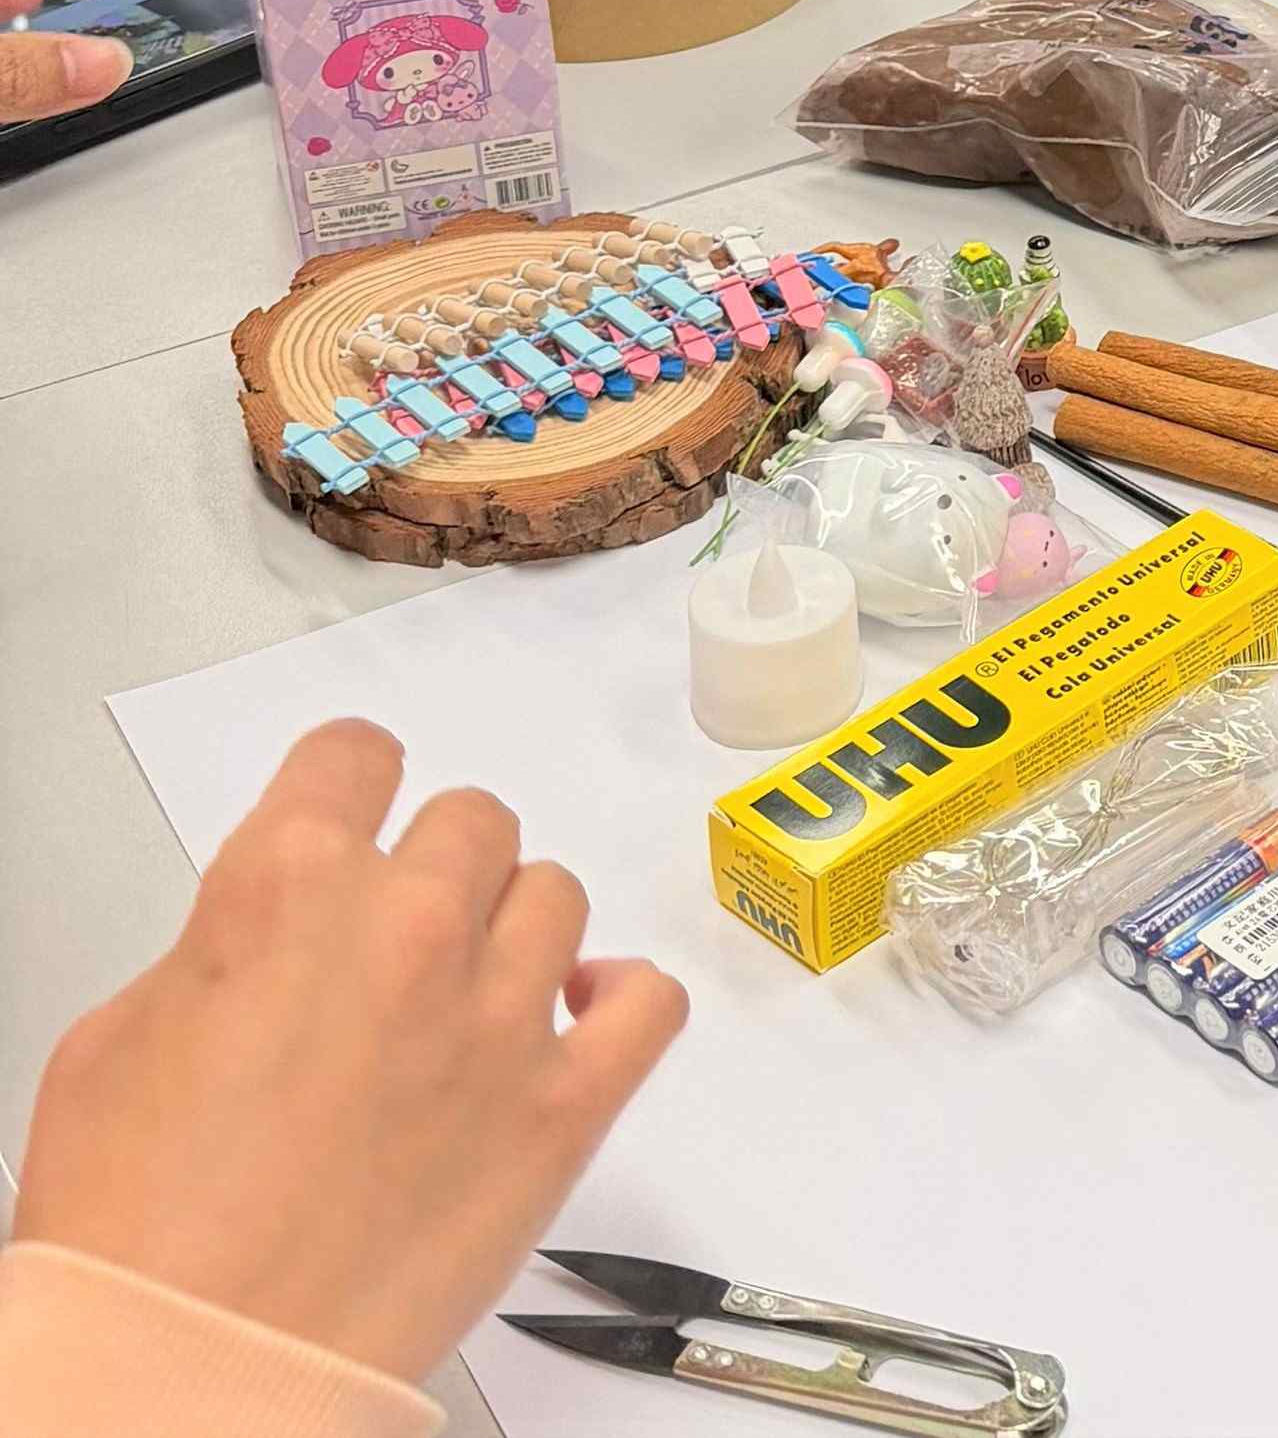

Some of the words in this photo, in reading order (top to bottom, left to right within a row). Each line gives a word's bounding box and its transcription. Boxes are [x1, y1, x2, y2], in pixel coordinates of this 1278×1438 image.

[991, 646, 1015, 664] El
[1012, 586, 1120, 651] Pegamento
[1116, 530, 1206, 587] Universal
[1200, 561, 1223, 583] UHU
[1017, 664, 1043, 682] El
[1039, 613, 1131, 668] Pegatodo
[1045, 670, 1092, 700] Cola
[1089, 613, 1182, 672] Universal
[750, 673, 1012, 840] UHU
[736, 889, 805, 957] UHU
